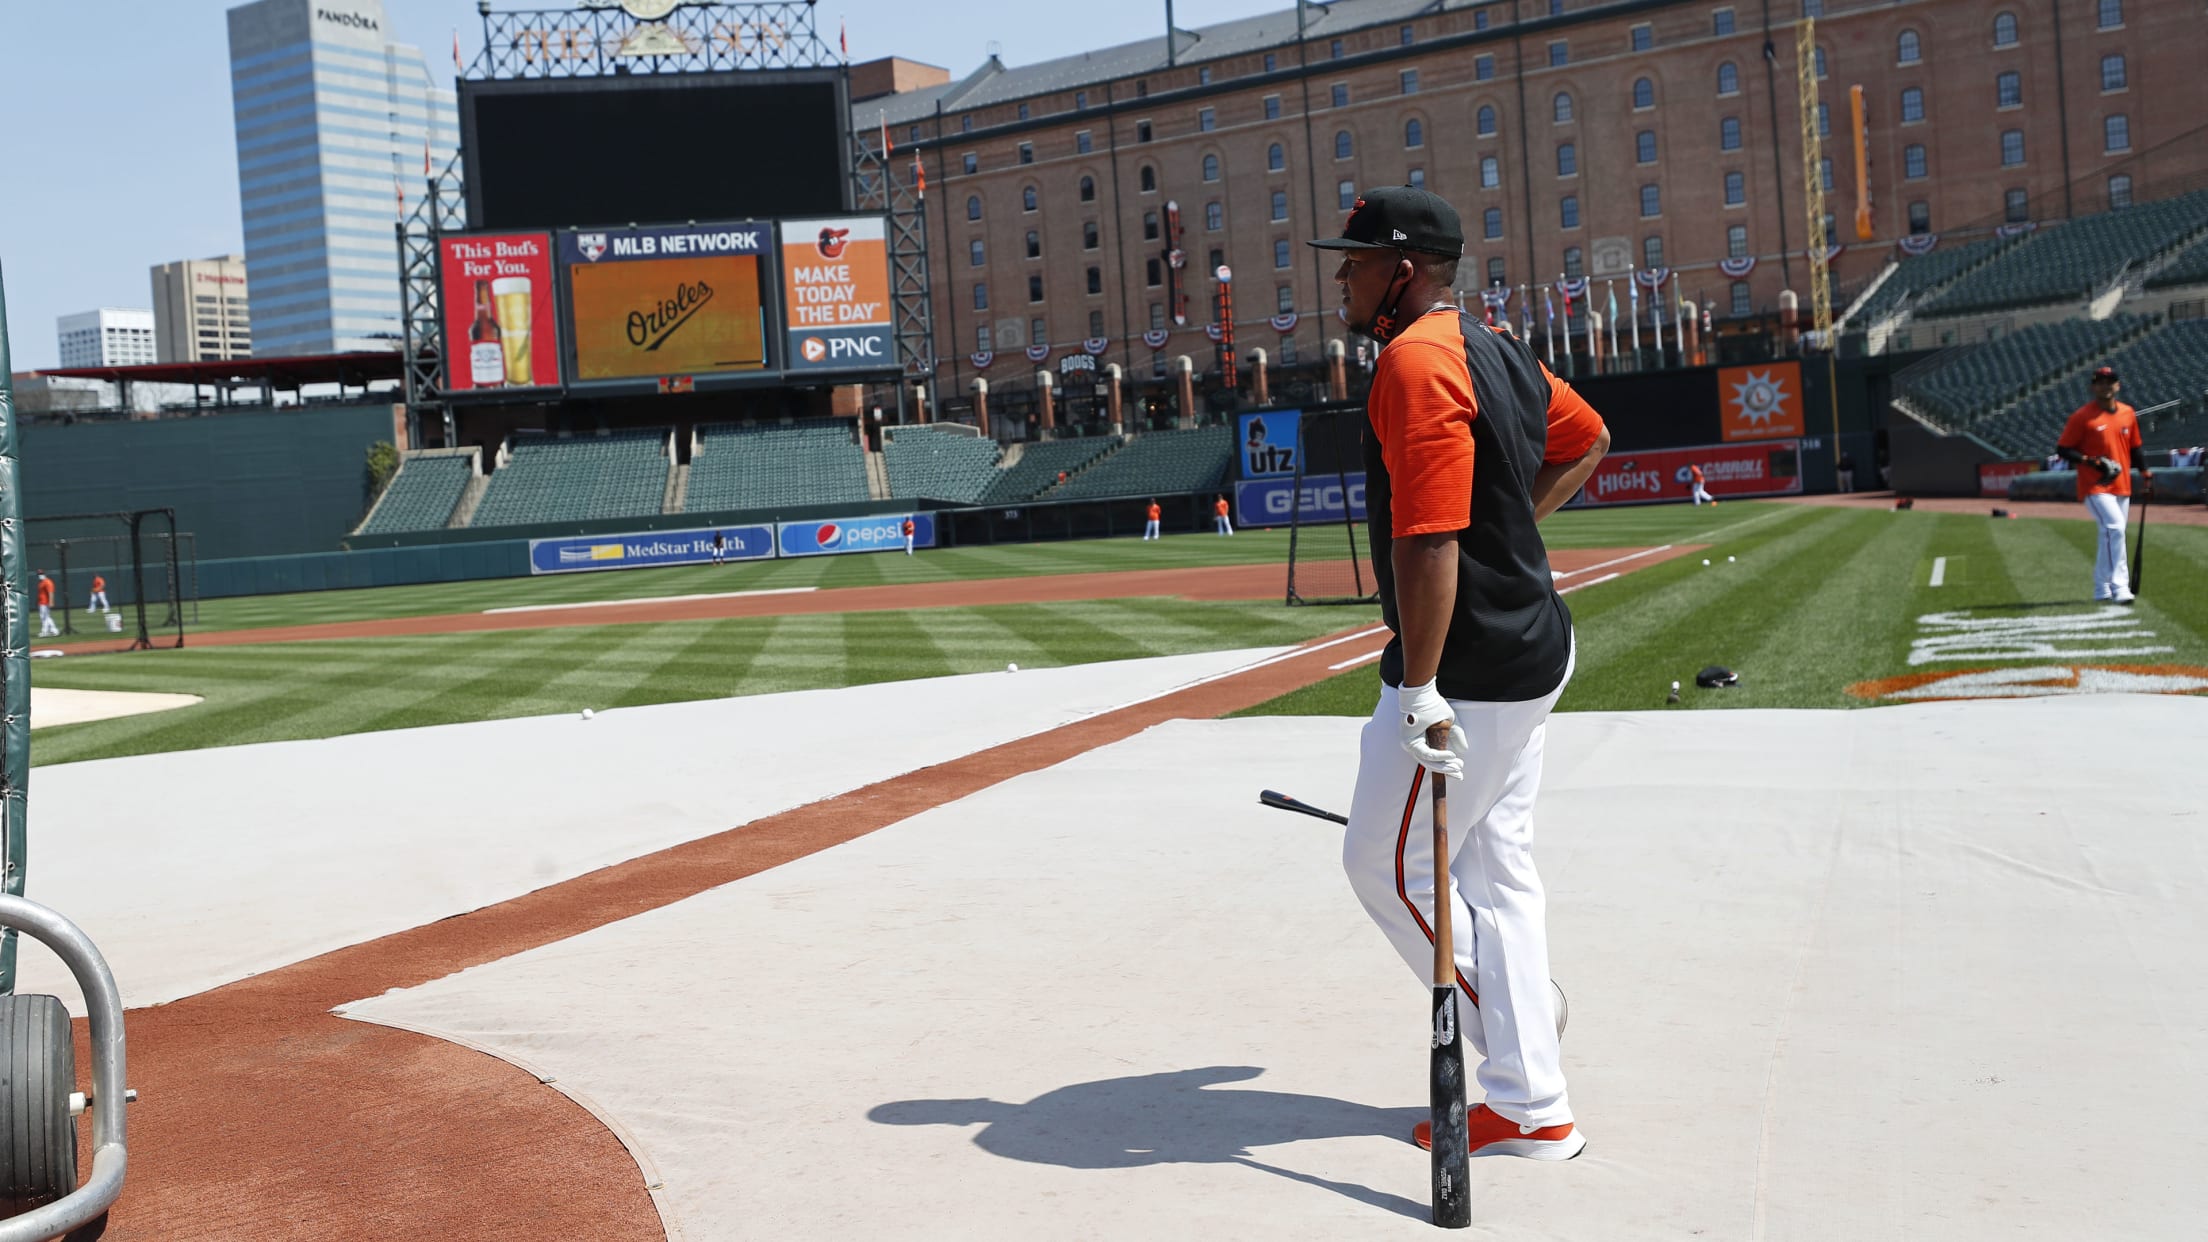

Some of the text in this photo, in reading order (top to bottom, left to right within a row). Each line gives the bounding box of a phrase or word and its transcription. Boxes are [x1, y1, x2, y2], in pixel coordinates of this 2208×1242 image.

[515, 22, 787, 61] THE SUN
[451, 240, 539, 259] This Bud's
[613, 231, 759, 256] MLB NETWORK
[463, 259, 530, 276] For You.
[793, 264, 850, 284] MAKE
[795, 284, 856, 304] TODAY
[626, 280, 714, 350] Orioles
[796, 304, 834, 323] THE
[1373, 315, 1395, 339] 28
[828, 335, 882, 359] PNC
[1702, 459, 1764, 474] CARROLL
[1597, 470, 1662, 496] HIGH'S
[847, 522, 901, 545] pepsi
[626, 536, 745, 558] MedStar Helth
